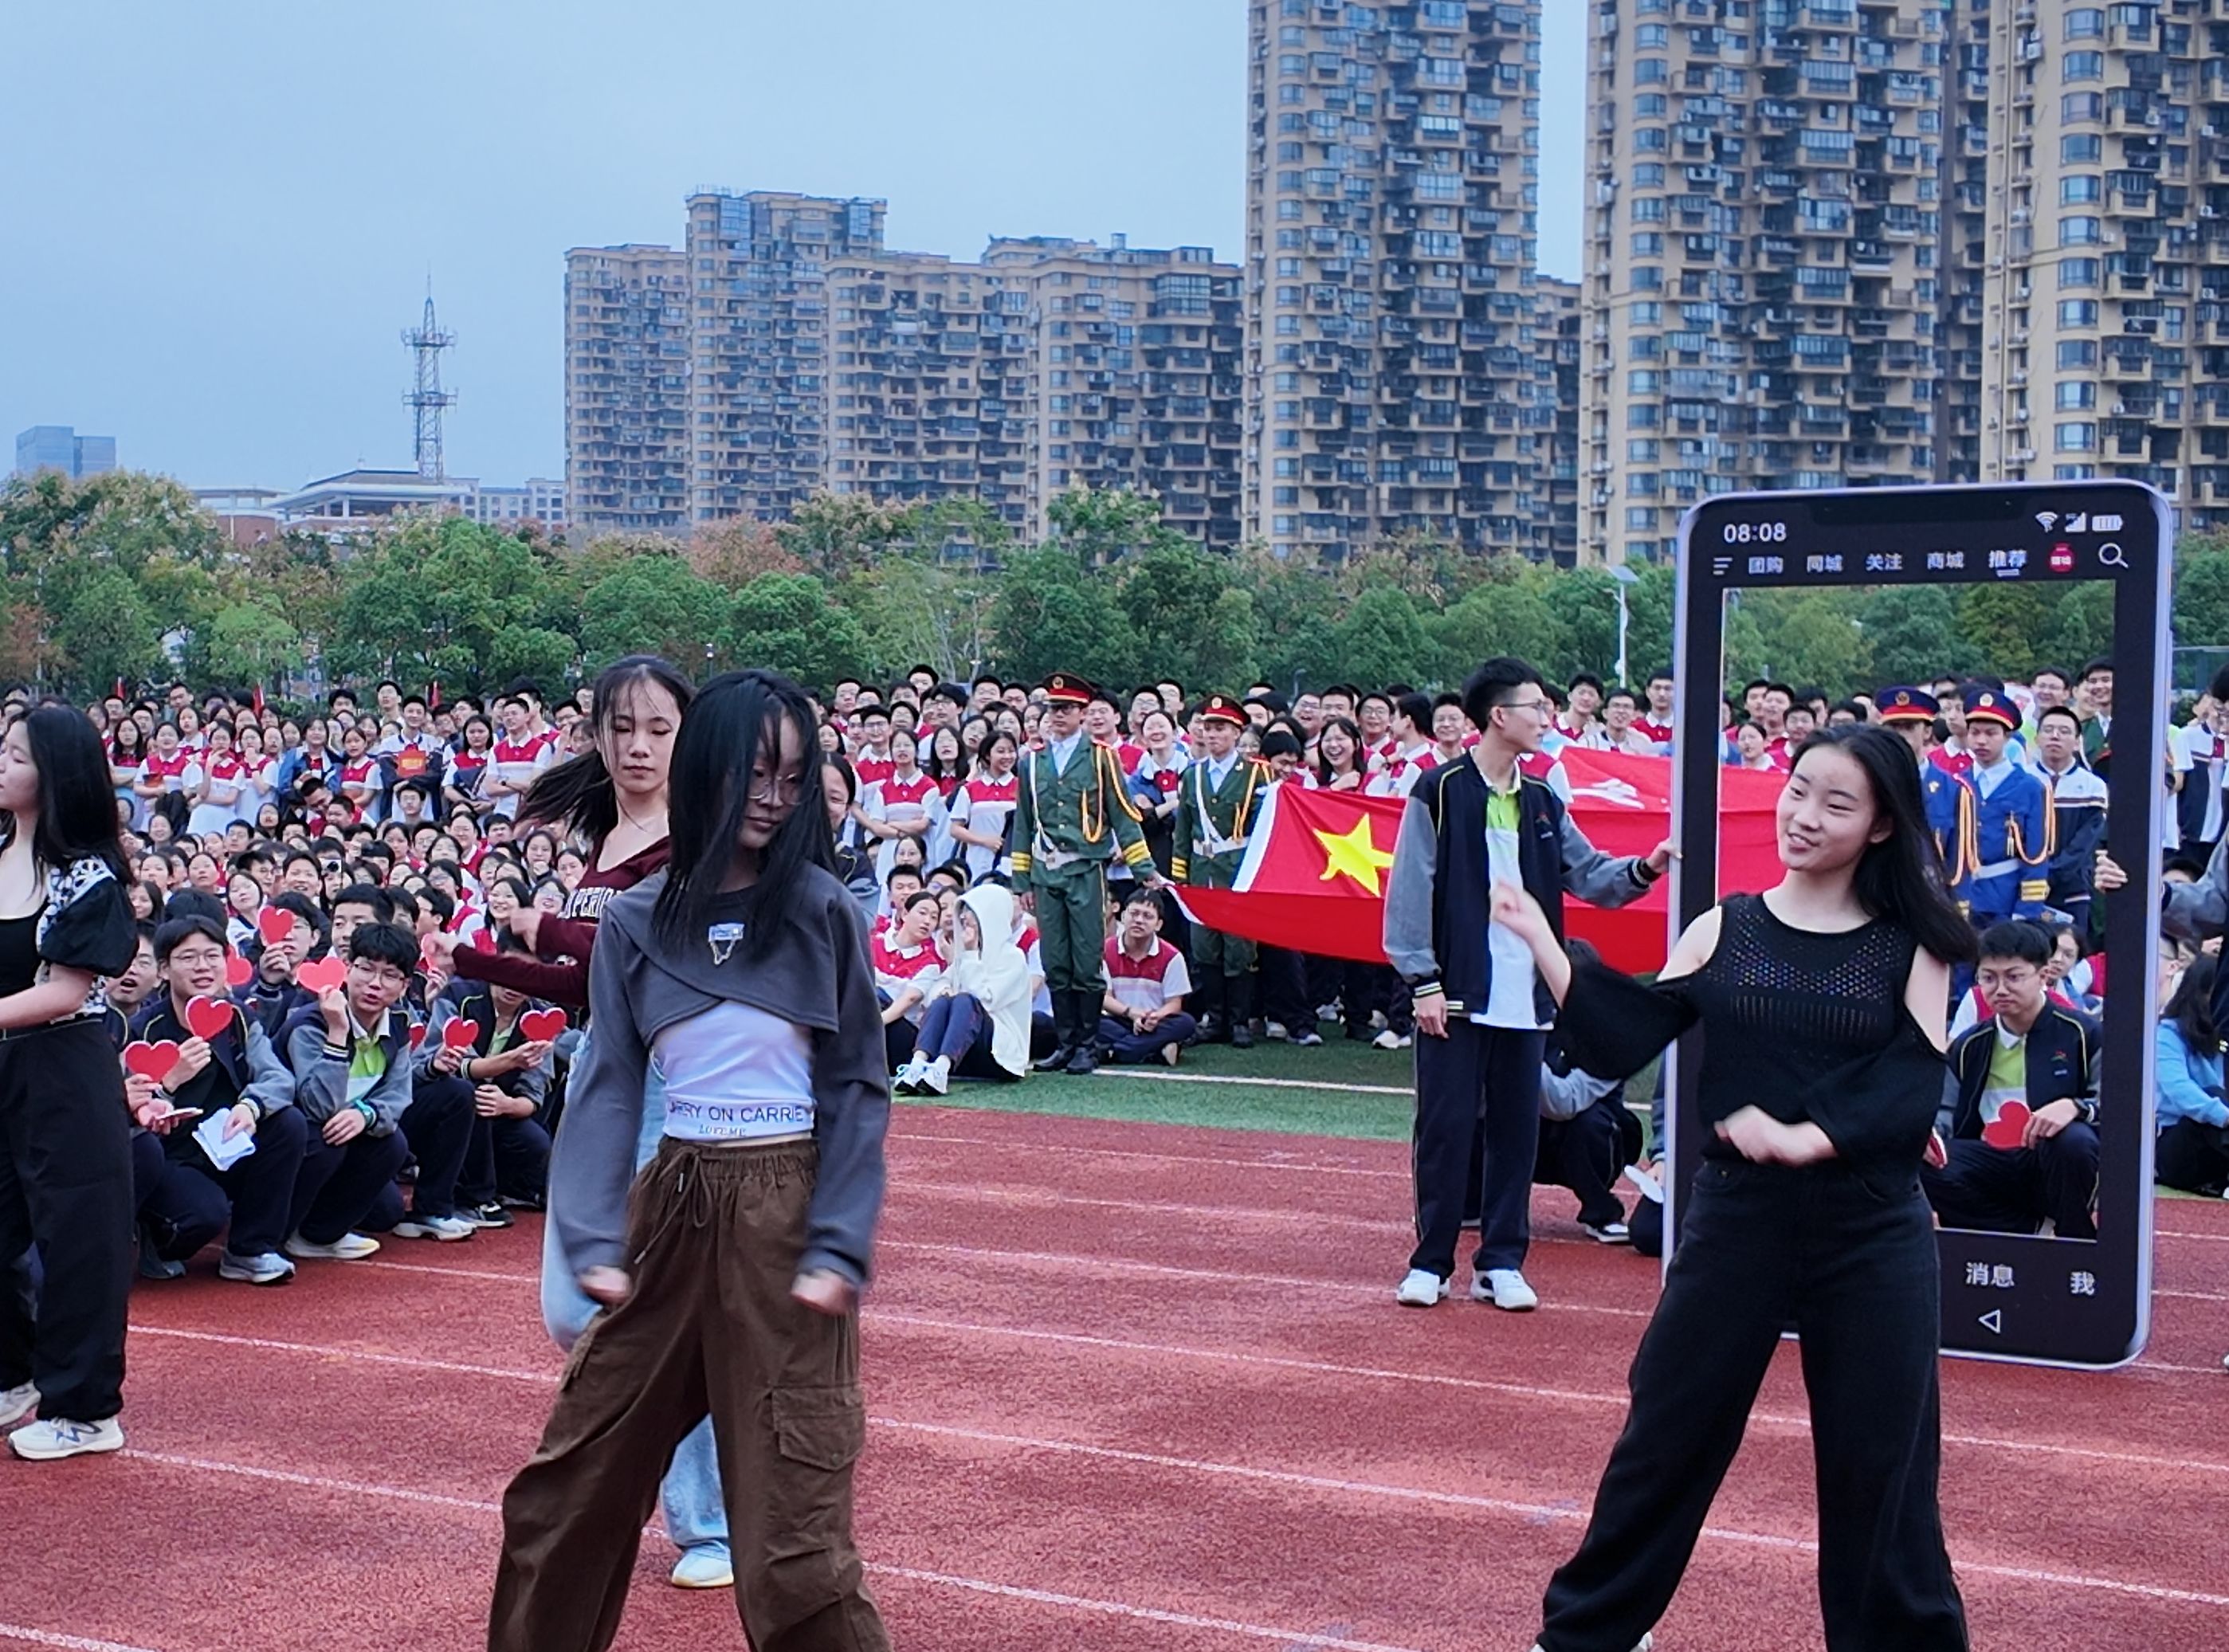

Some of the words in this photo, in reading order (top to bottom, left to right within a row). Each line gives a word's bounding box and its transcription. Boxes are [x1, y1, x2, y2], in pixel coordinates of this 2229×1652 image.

[1724, 522, 1787, 543] 08:08
[1748, 555, 1784, 575] 团购
[1806, 554, 1843, 573] 同城
[1866, 552, 1903, 571] 关注
[1927, 551, 1964, 570] 商城
[1988, 549, 2027, 568] 推荐
[708, 1106, 733, 1122] ON
[740, 1105, 804, 1123] CARRIE
[1965, 1262, 2015, 1288] 消息
[2070, 1271, 2095, 1296] 我
